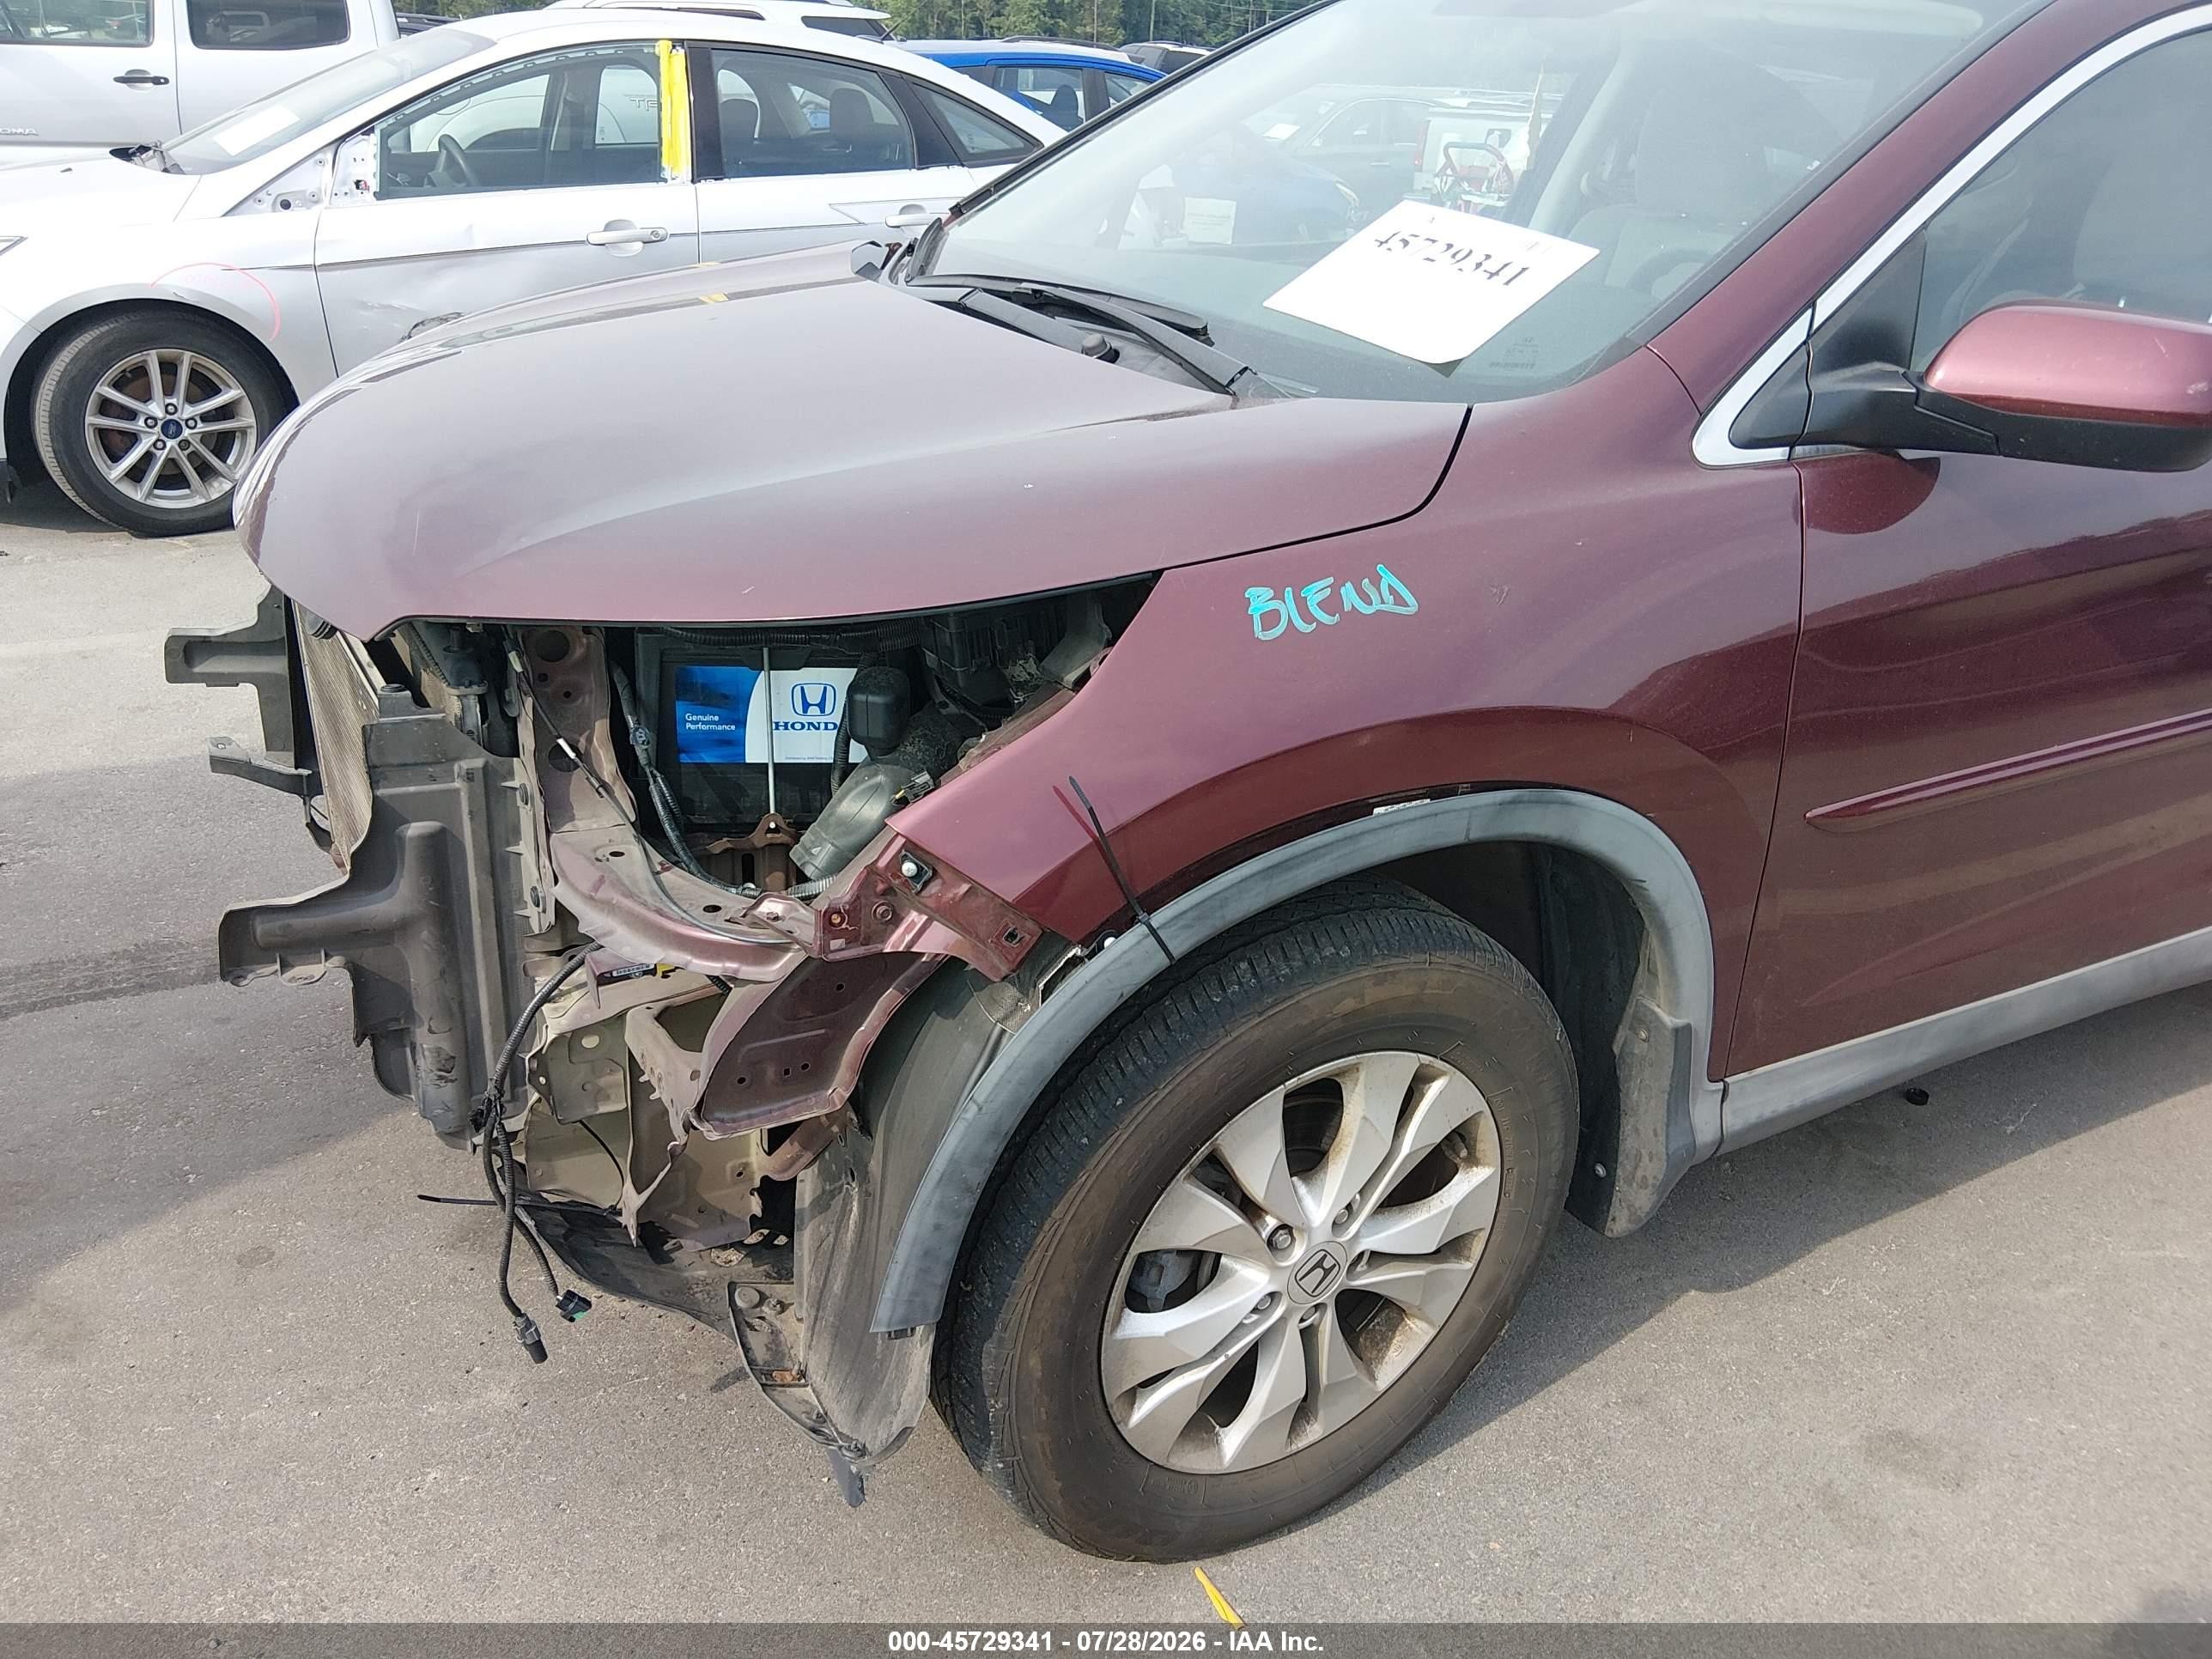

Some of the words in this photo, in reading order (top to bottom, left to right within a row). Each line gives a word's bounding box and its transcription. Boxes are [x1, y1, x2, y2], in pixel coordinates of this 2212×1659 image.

[1374, 229, 1531, 287] 45729341
[684, 713, 720, 721] Genuine
[685, 722, 736, 731] Performance
[773, 720, 839, 731] HOND
